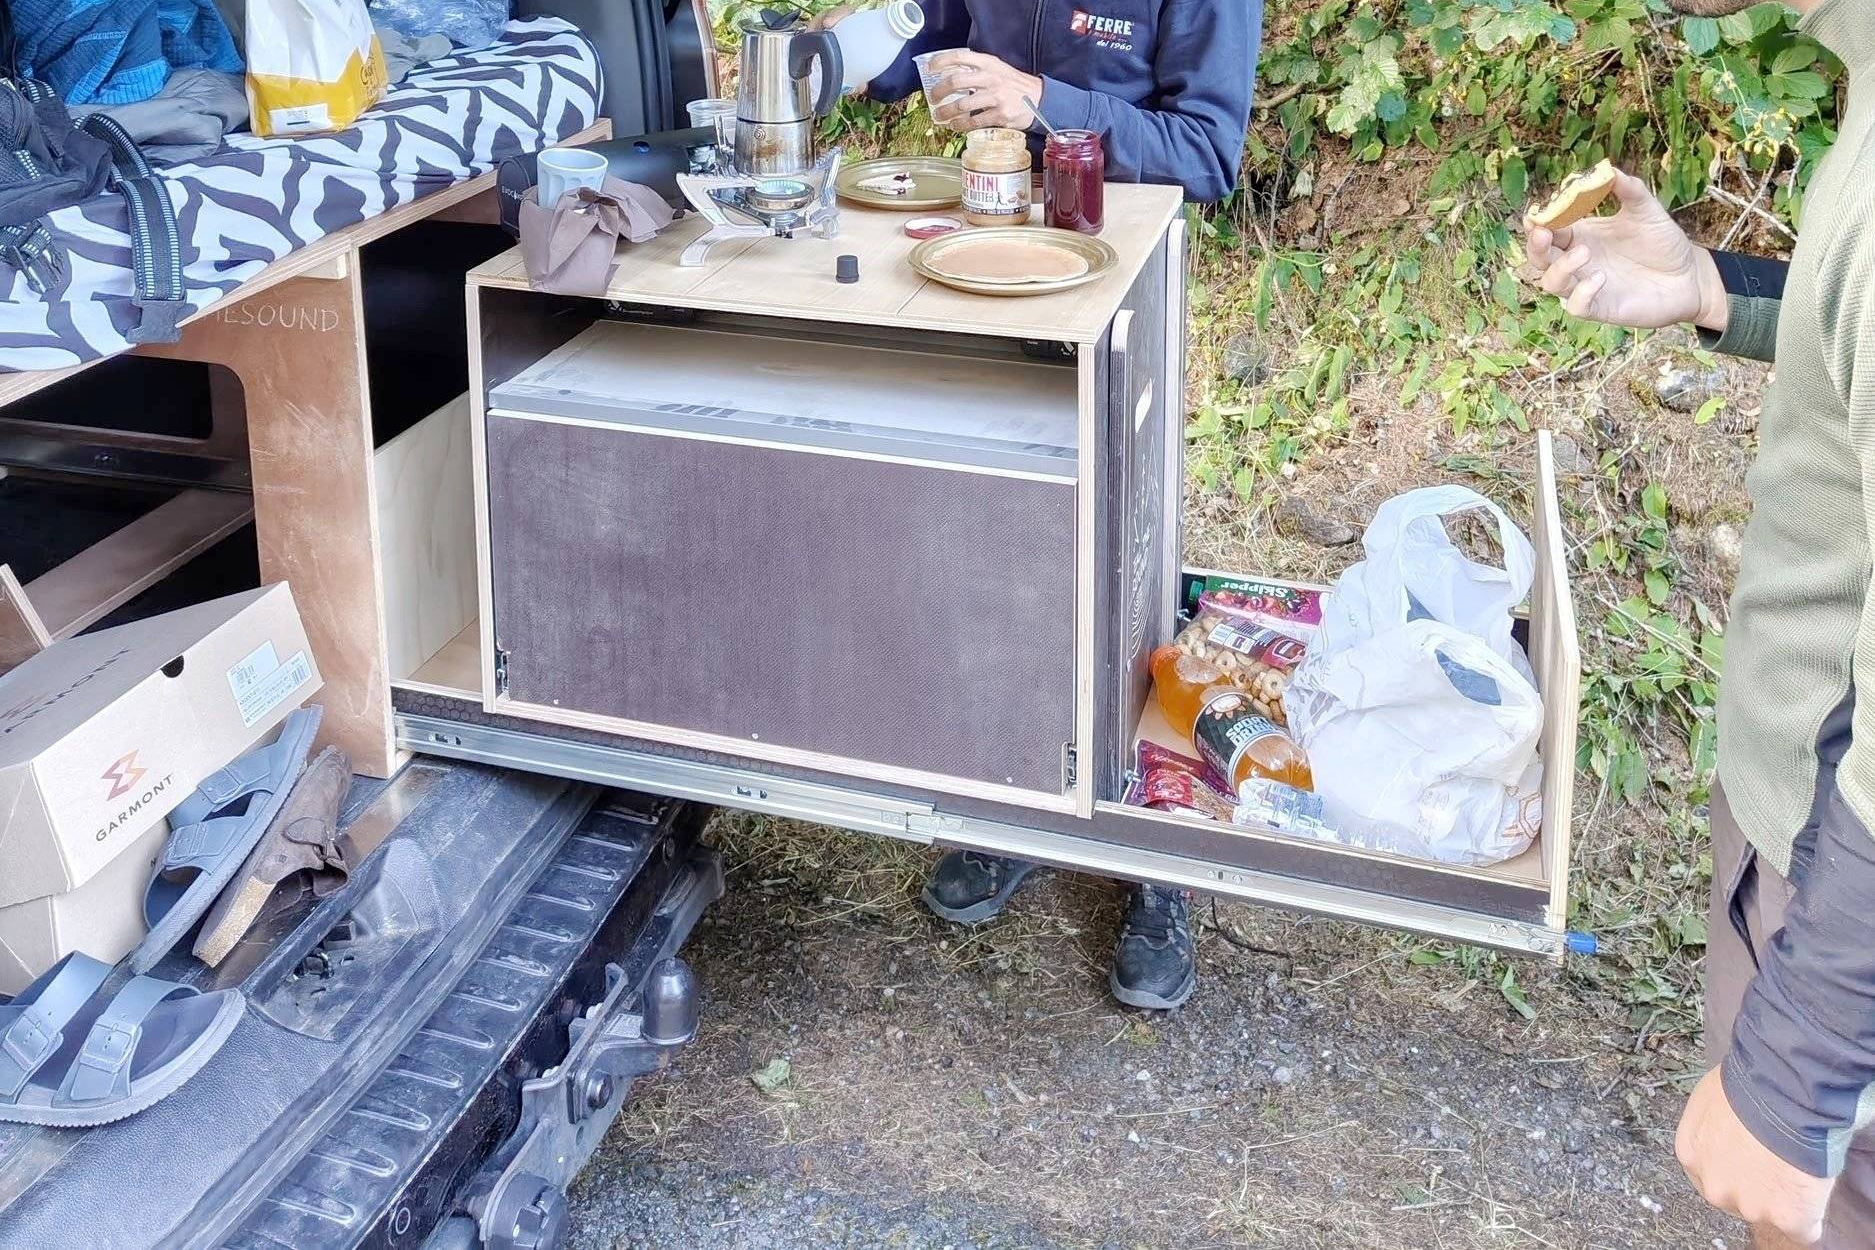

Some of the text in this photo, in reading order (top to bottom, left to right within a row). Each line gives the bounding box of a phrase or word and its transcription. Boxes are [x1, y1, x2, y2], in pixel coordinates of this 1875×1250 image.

[1109, 40, 1133, 51] 1960
[1220, 580, 1289, 598] Skipper
[95, 772, 174, 842] GARMONT
